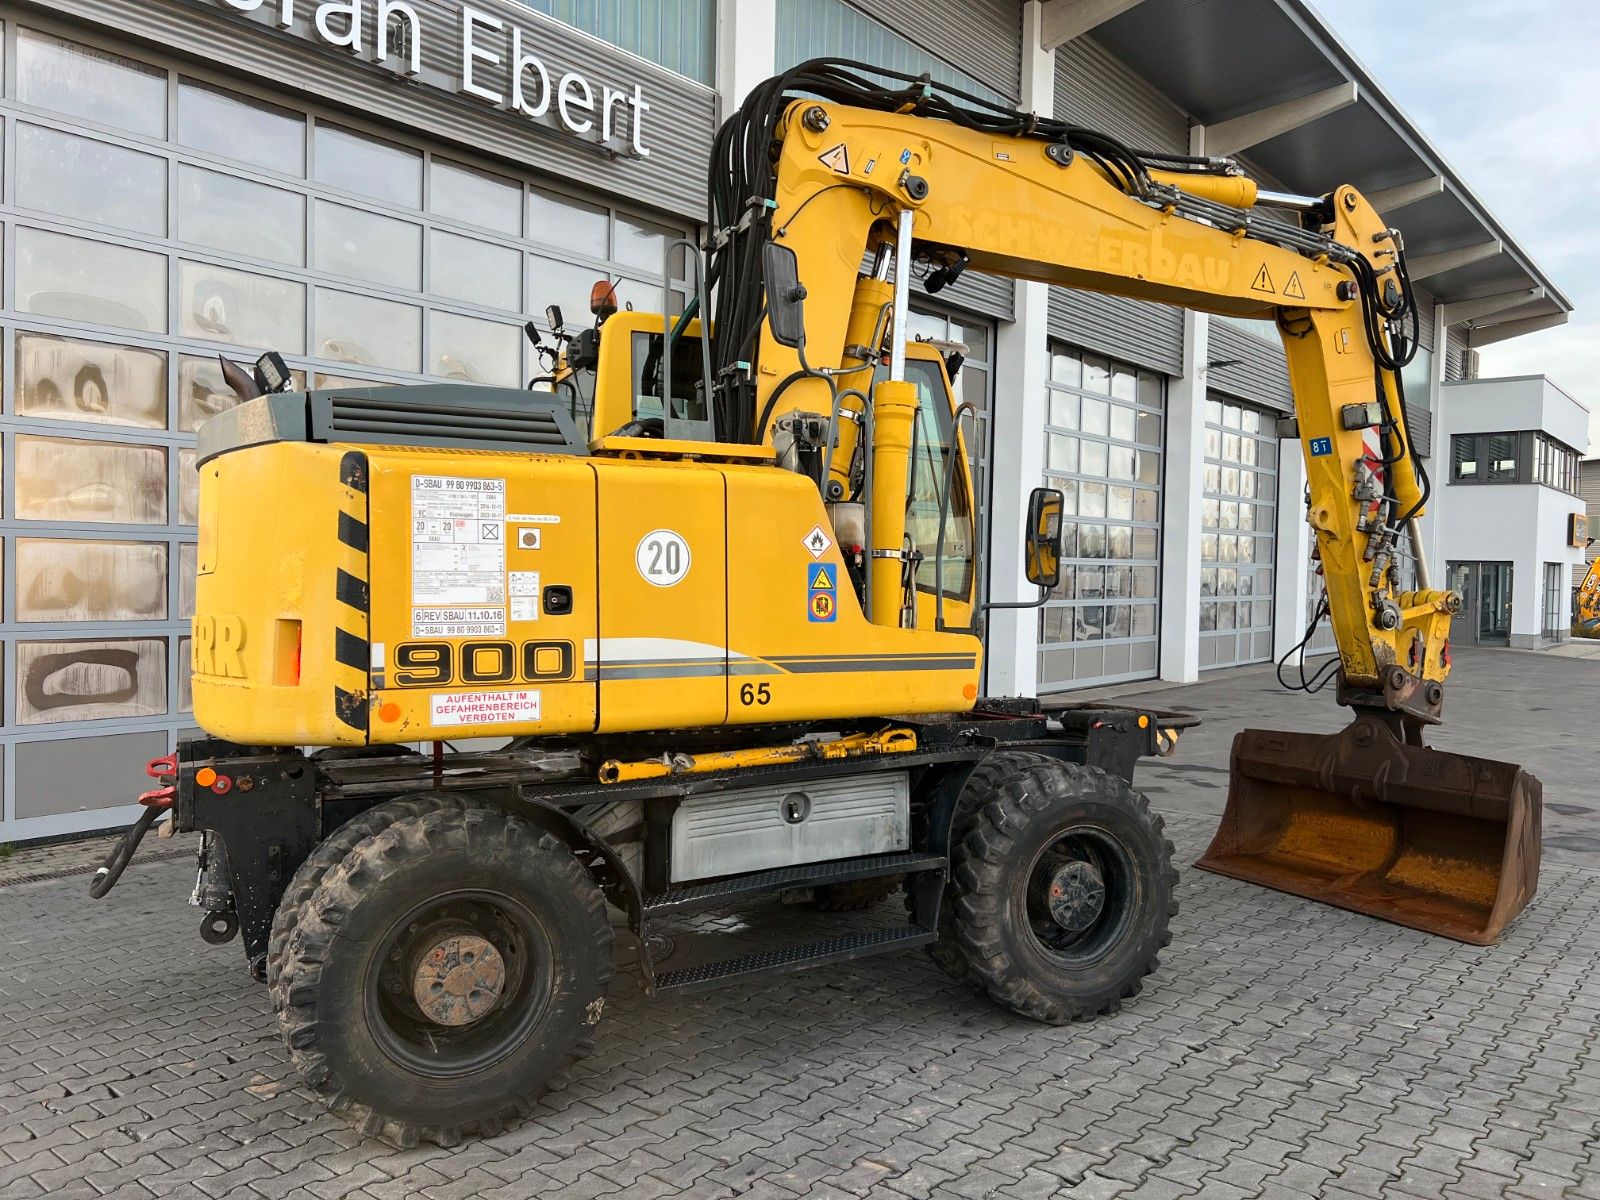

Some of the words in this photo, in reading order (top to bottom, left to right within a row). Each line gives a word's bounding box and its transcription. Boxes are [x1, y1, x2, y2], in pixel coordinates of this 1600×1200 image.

[462, 6, 650, 156] Ebert
[415, 478, 442, 488] D-SBAU
[446, 480, 455, 489] 99
[455, 480, 465, 490] 80
[465, 481, 482, 490] 9903
[416, 521, 425, 531] 20
[443, 522, 452, 531] 20
[647, 540, 680, 575] 20
[415, 612, 422, 620] 6
[423, 611, 441, 621] REV
[443, 611, 465, 620] SBAU
[468, 610, 503, 620] 11.10.16
[415, 626, 443, 635] D-SBAU
[447, 626, 455, 634] 99
[456, 625, 465, 634] 80
[394, 640, 576, 686] 900
[446, 692, 514, 704] AUFENTHALT
[516, 692, 528, 700] IM
[740, 683, 771, 706] 65
[436, 701, 537, 714] GEFAHRENBEREICH
[459, 712, 515, 722] VERBOTEN
